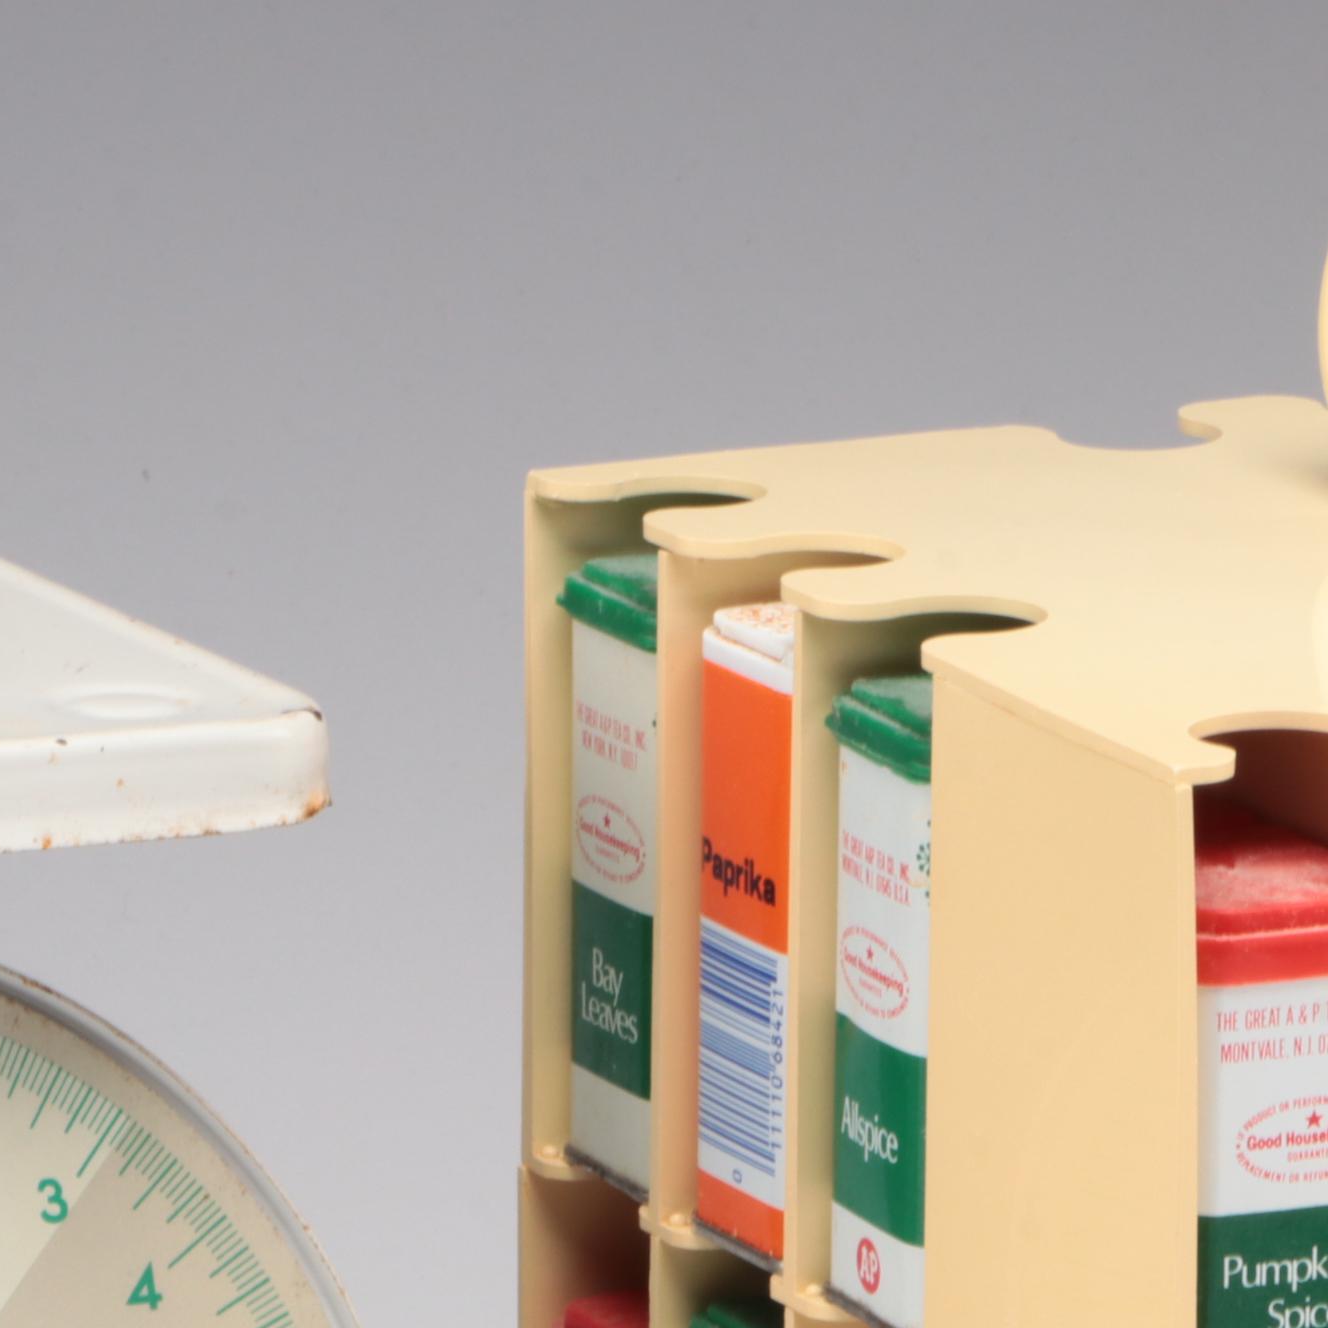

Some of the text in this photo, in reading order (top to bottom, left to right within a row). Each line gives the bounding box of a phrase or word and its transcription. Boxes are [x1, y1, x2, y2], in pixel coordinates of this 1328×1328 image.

[701, 836, 776, 907] Paprika
[591, 946, 624, 1007] Bay
[581, 980, 638, 1045] Leaves
[1217, 1011, 1238, 1032] THE
[1245, 1007, 1281, 1031] GREAT
[1286, 1004, 1294, 1026] A
[1298, 1003, 1307, 1025] &
[1312, 1002, 1321, 1023] P
[841, 1095, 899, 1165] Allspice
[1246, 1131, 1282, 1151] Good
[38, 1178, 68, 1223] 3
[128, 1265, 163, 1309] 4
